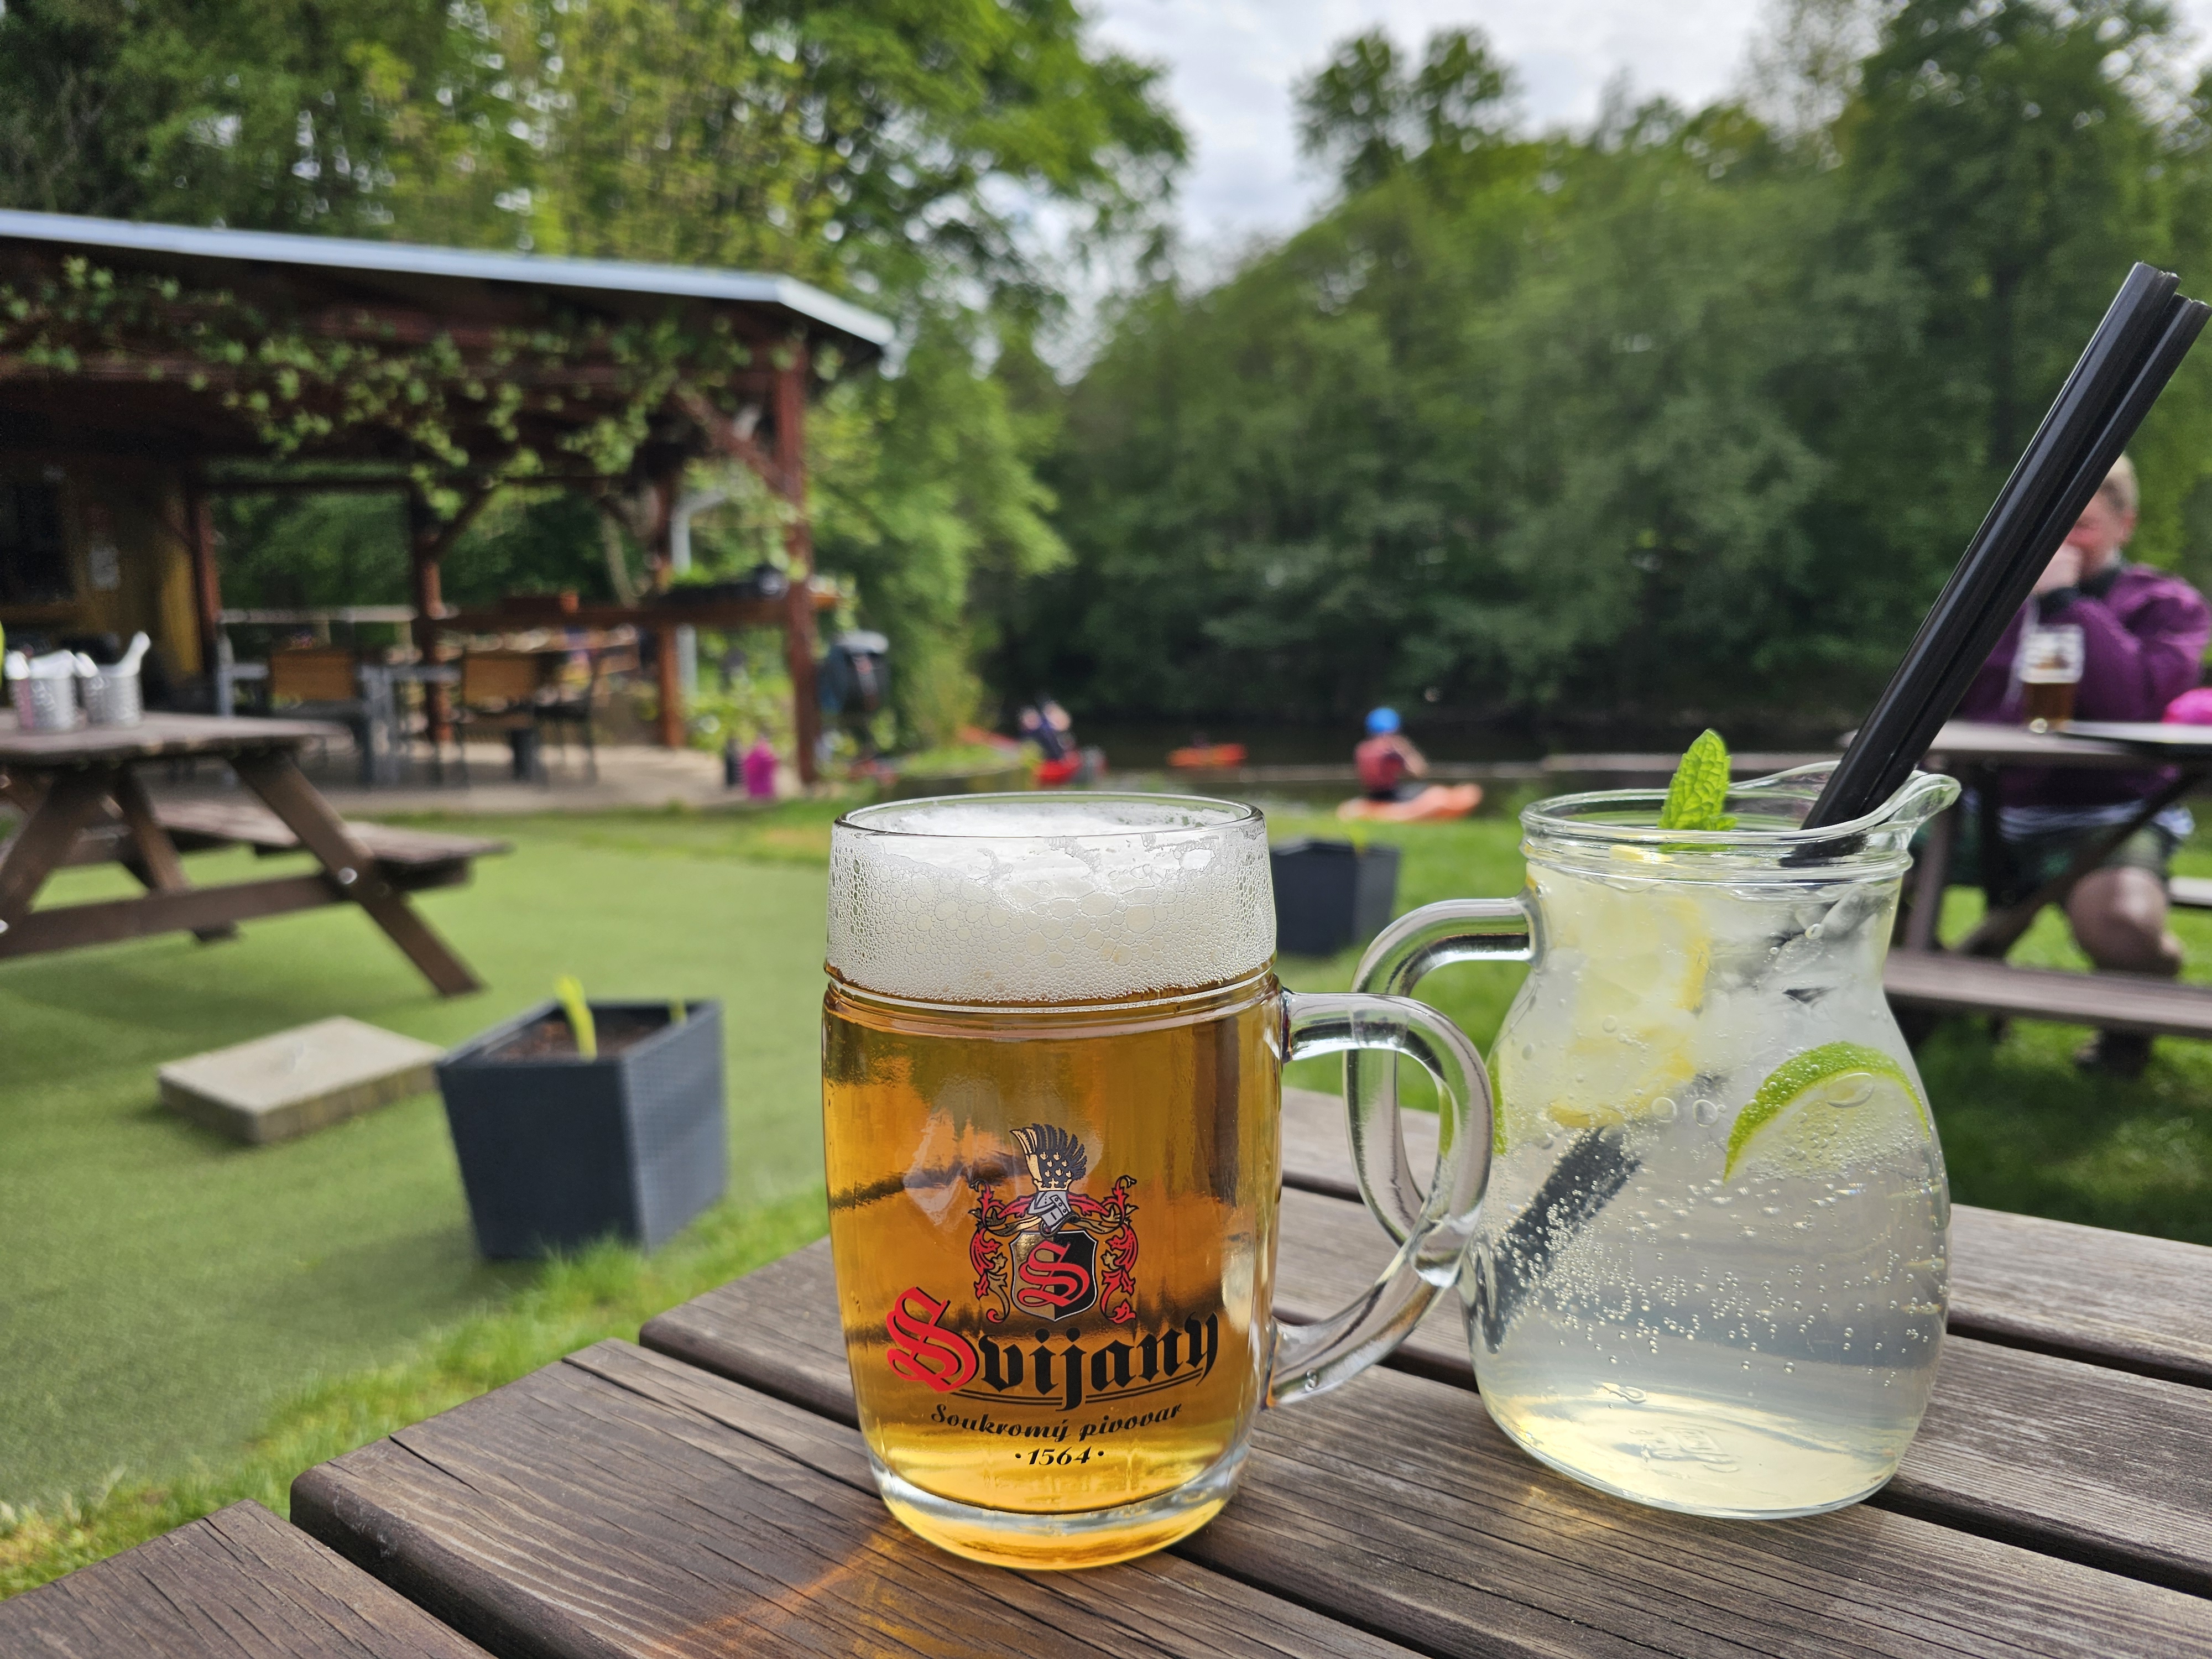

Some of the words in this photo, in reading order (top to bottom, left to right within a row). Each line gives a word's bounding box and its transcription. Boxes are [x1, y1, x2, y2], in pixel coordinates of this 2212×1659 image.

[1019, 1240, 1090, 1308] S
[886, 1286, 1218, 1411] Svijany
[931, 1404, 1071, 1442] Soukromý
[1079, 1402, 1182, 1442] pivovar
